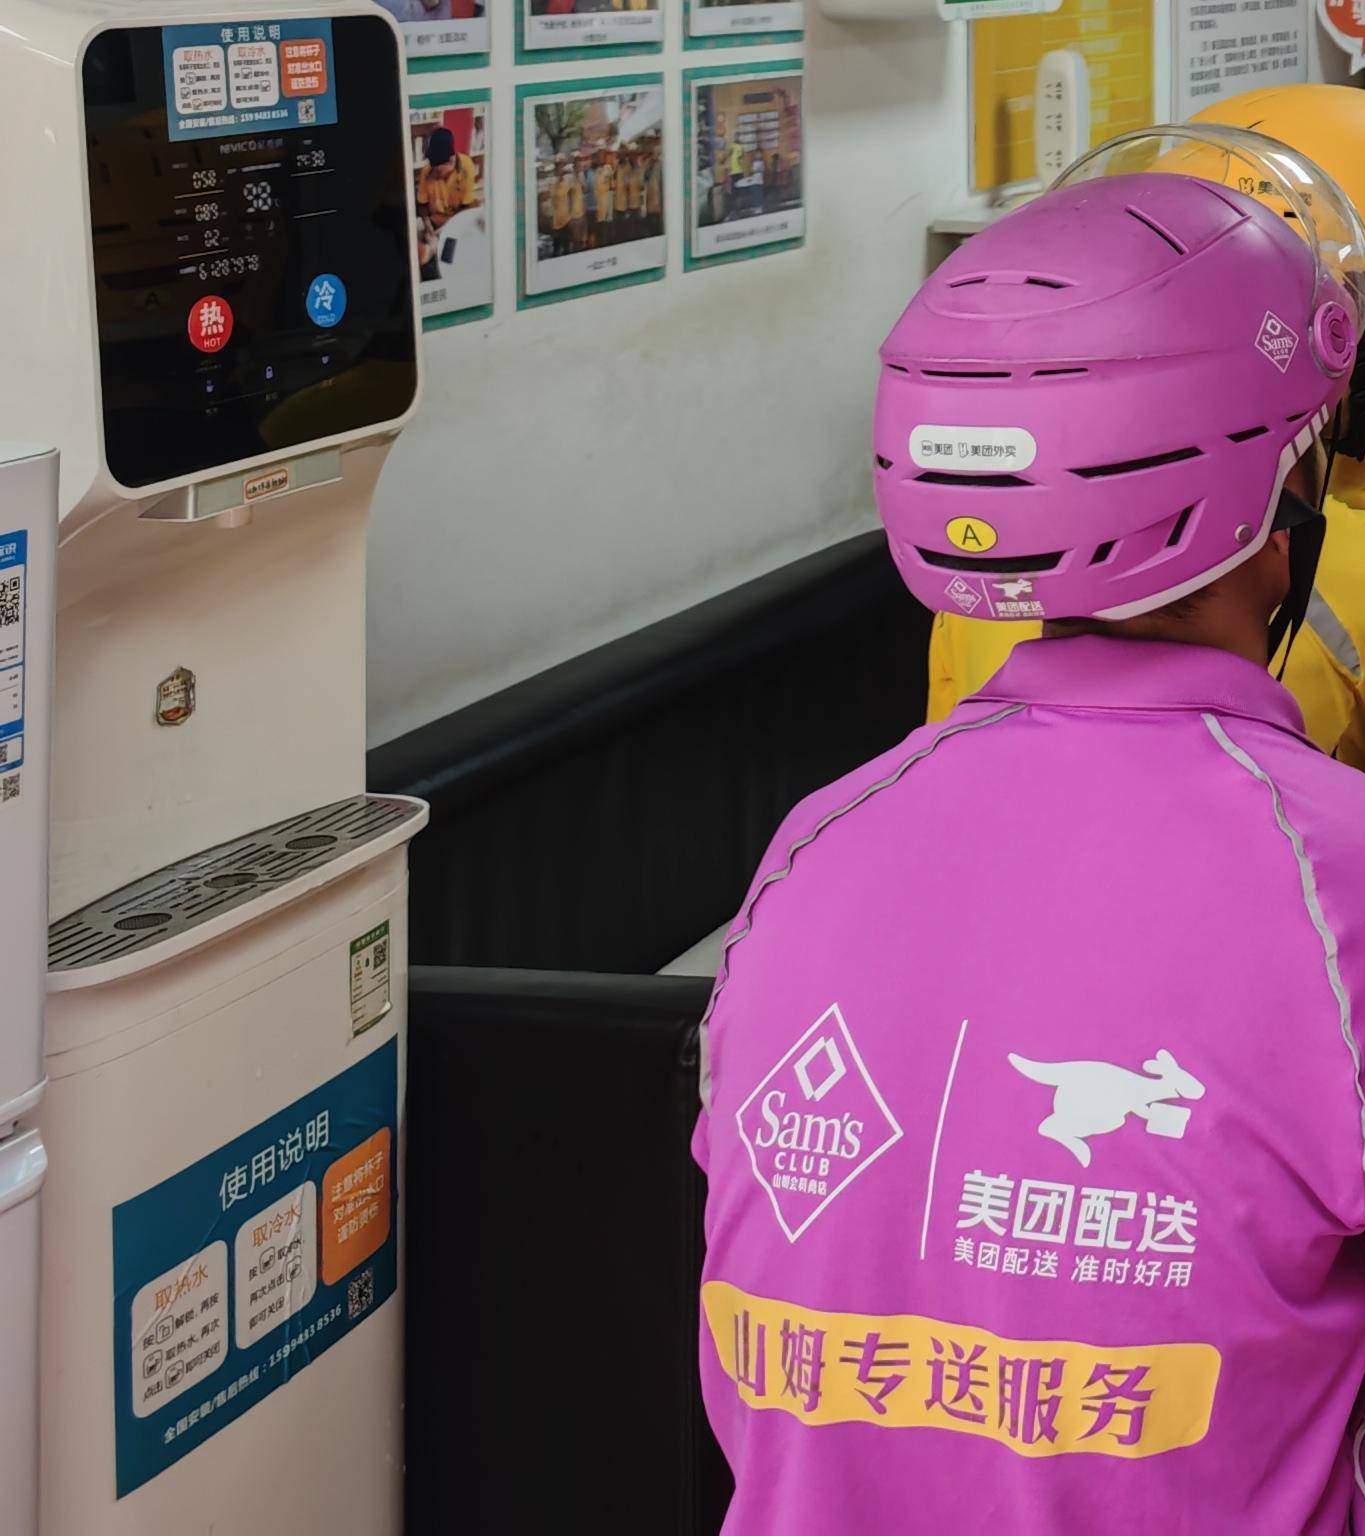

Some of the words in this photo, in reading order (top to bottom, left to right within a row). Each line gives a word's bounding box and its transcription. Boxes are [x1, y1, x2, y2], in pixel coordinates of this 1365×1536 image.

[221, 25, 281, 42] 使用说明
[243, 181, 272, 211] 98
[314, 279, 337, 311] 冷
[200, 301, 225, 336] 热
[203, 336, 222, 349] HOT
[934, 443, 953, 456] 美团
[971, 444, 1017, 458] 美团外卖
[961, 523, 983, 546] A
[755, 1091, 863, 1160] Sam's
[219, 1110, 329, 1212] 使用说明
[774, 1152, 830, 1176] CLUB
[252, 1203, 302, 1247] 取冷水
[956, 1169, 1198, 1254] 美团配送
[953, 1237, 1059, 1279] 美团配送
[1071, 1254, 1194, 1289] 准时好用
[154, 1264, 209, 1311] 取热水
[733, 1308, 1157, 1447] 山姆专送服务
